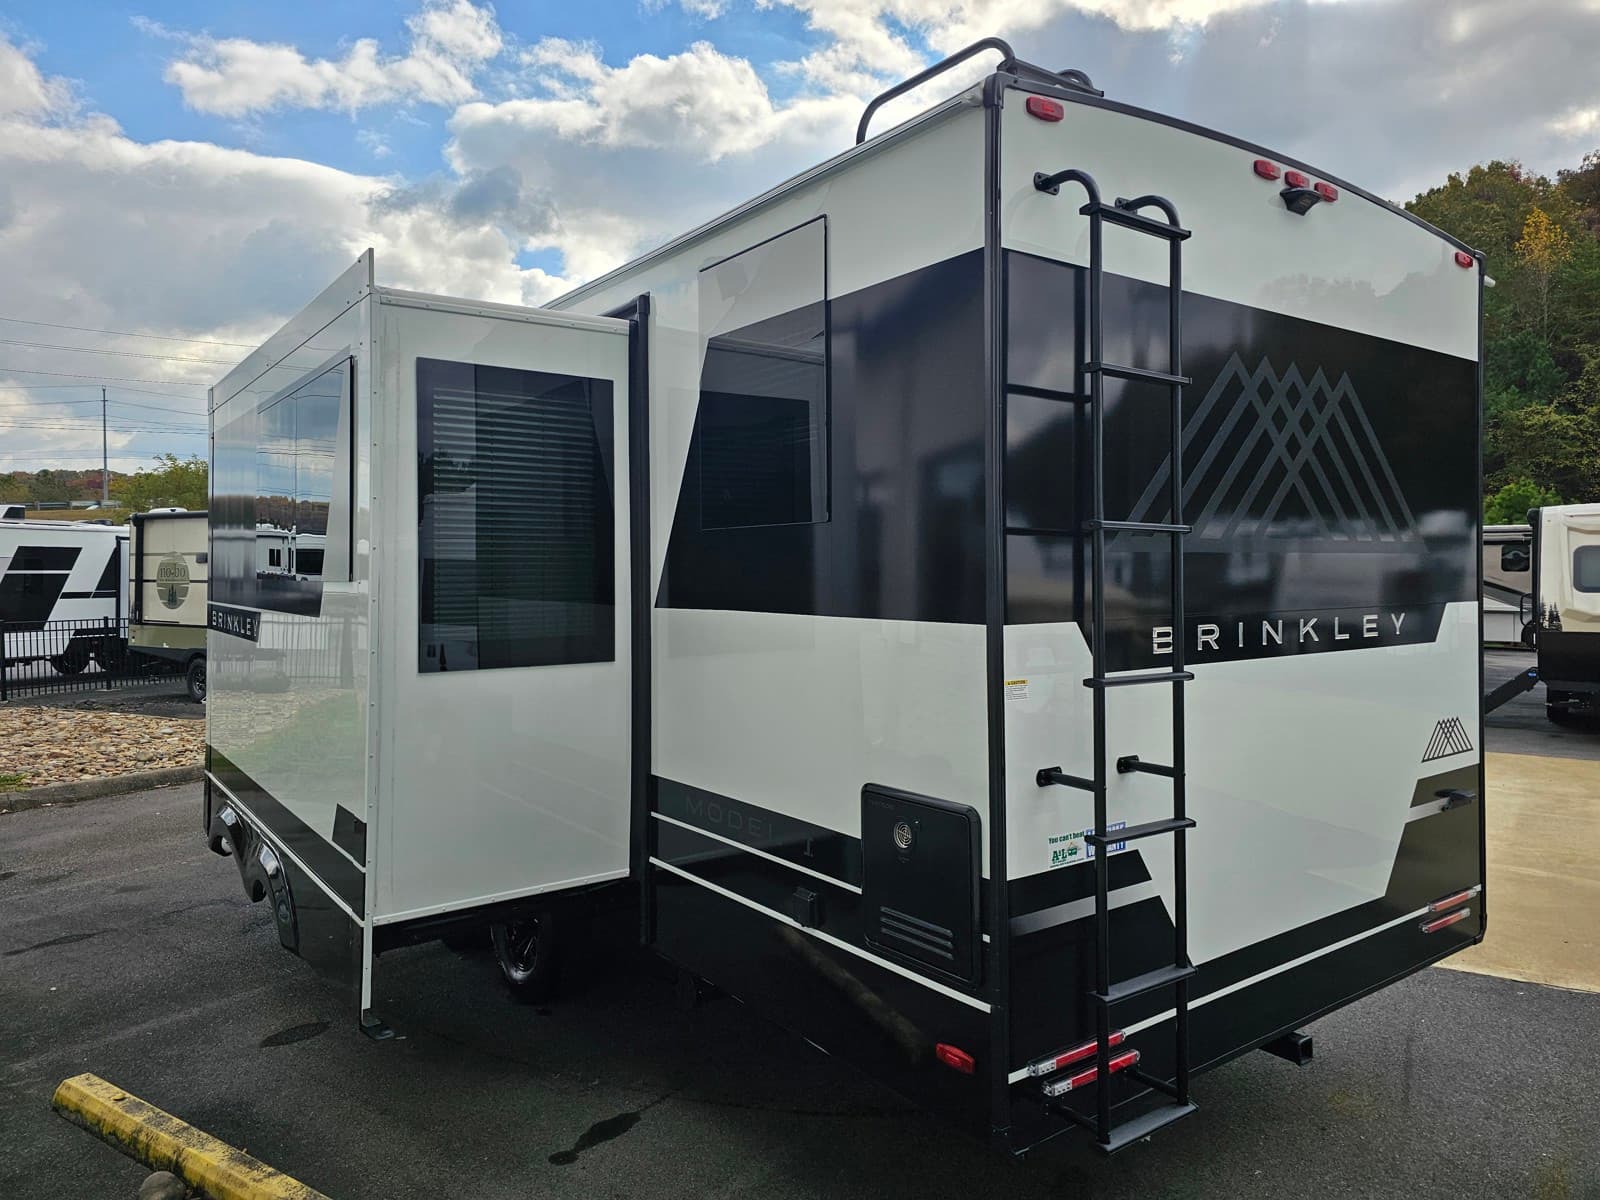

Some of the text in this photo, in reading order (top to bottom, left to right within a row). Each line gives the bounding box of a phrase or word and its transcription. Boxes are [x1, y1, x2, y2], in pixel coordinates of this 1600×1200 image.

[212, 610, 258, 637] BRINKLEY
[1152, 612, 1406, 655] BRINKLEY
[686, 794, 784, 846] MODEL
[1048, 836, 1059, 845] You
[1059, 833, 1073, 842] can't
